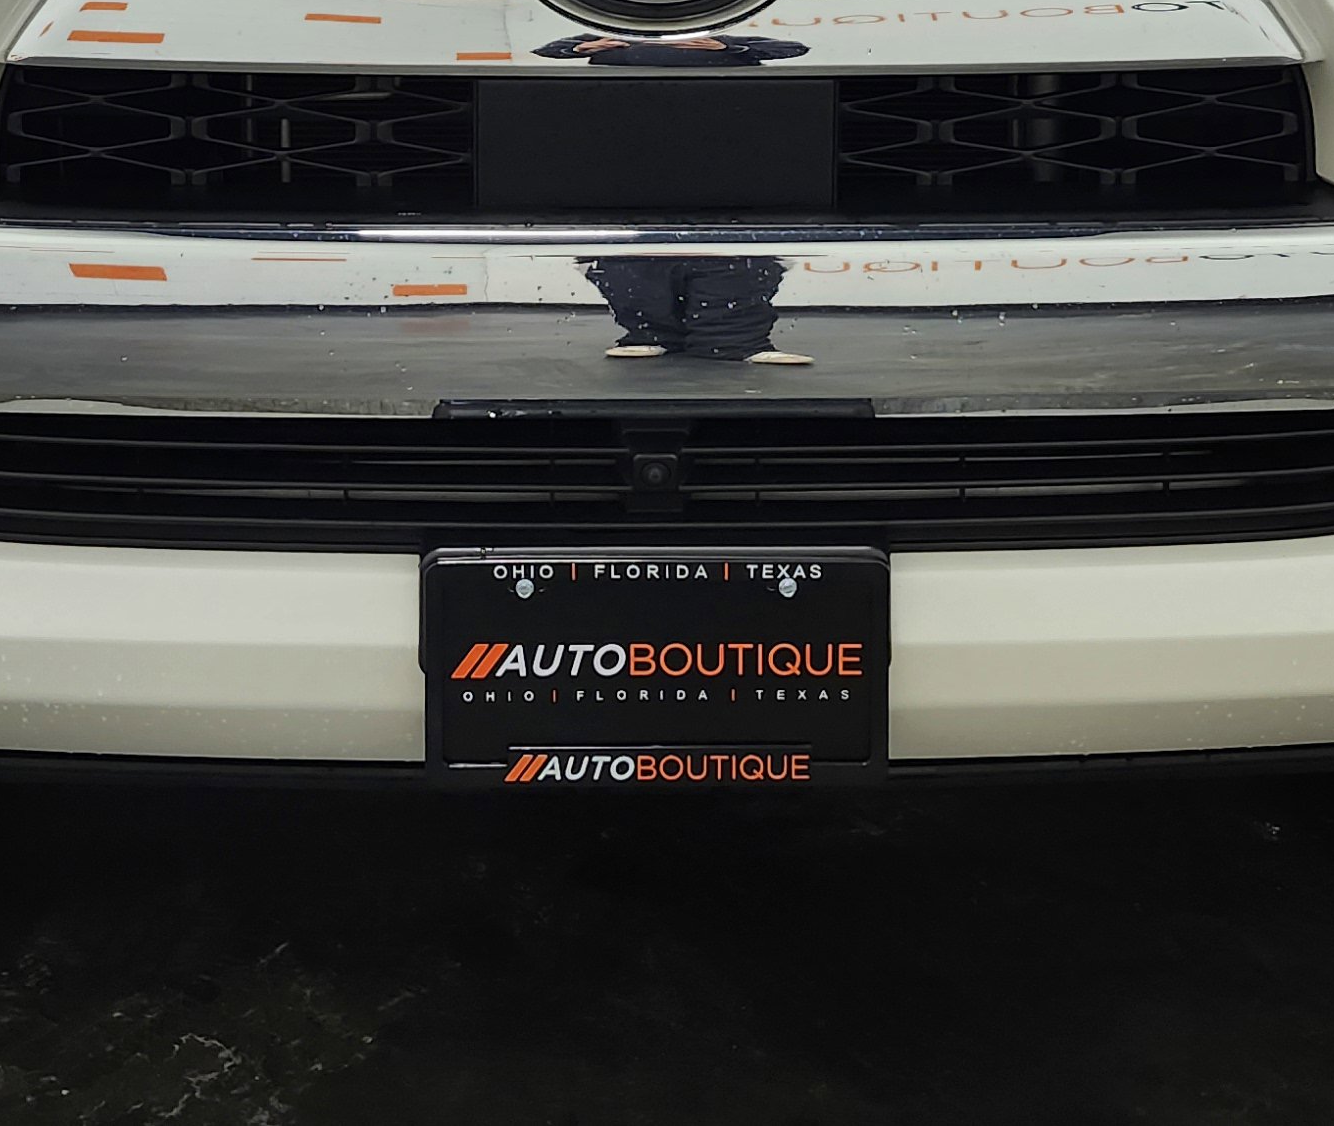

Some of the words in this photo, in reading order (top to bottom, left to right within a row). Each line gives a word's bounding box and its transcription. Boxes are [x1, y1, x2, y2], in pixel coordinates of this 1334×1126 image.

[492, 564, 554, 579] OHIO
[593, 564, 709, 579] FLORIDA
[746, 564, 822, 579] TEXAS
[495, 643, 863, 677] AUTOBOUTIQUE
[462, 689, 535, 702] OHIO
[576, 689, 708, 701] FLORIDA
[755, 688, 850, 701] TEXAS
[537, 754, 811, 782] AUTOBOUTIQUE
